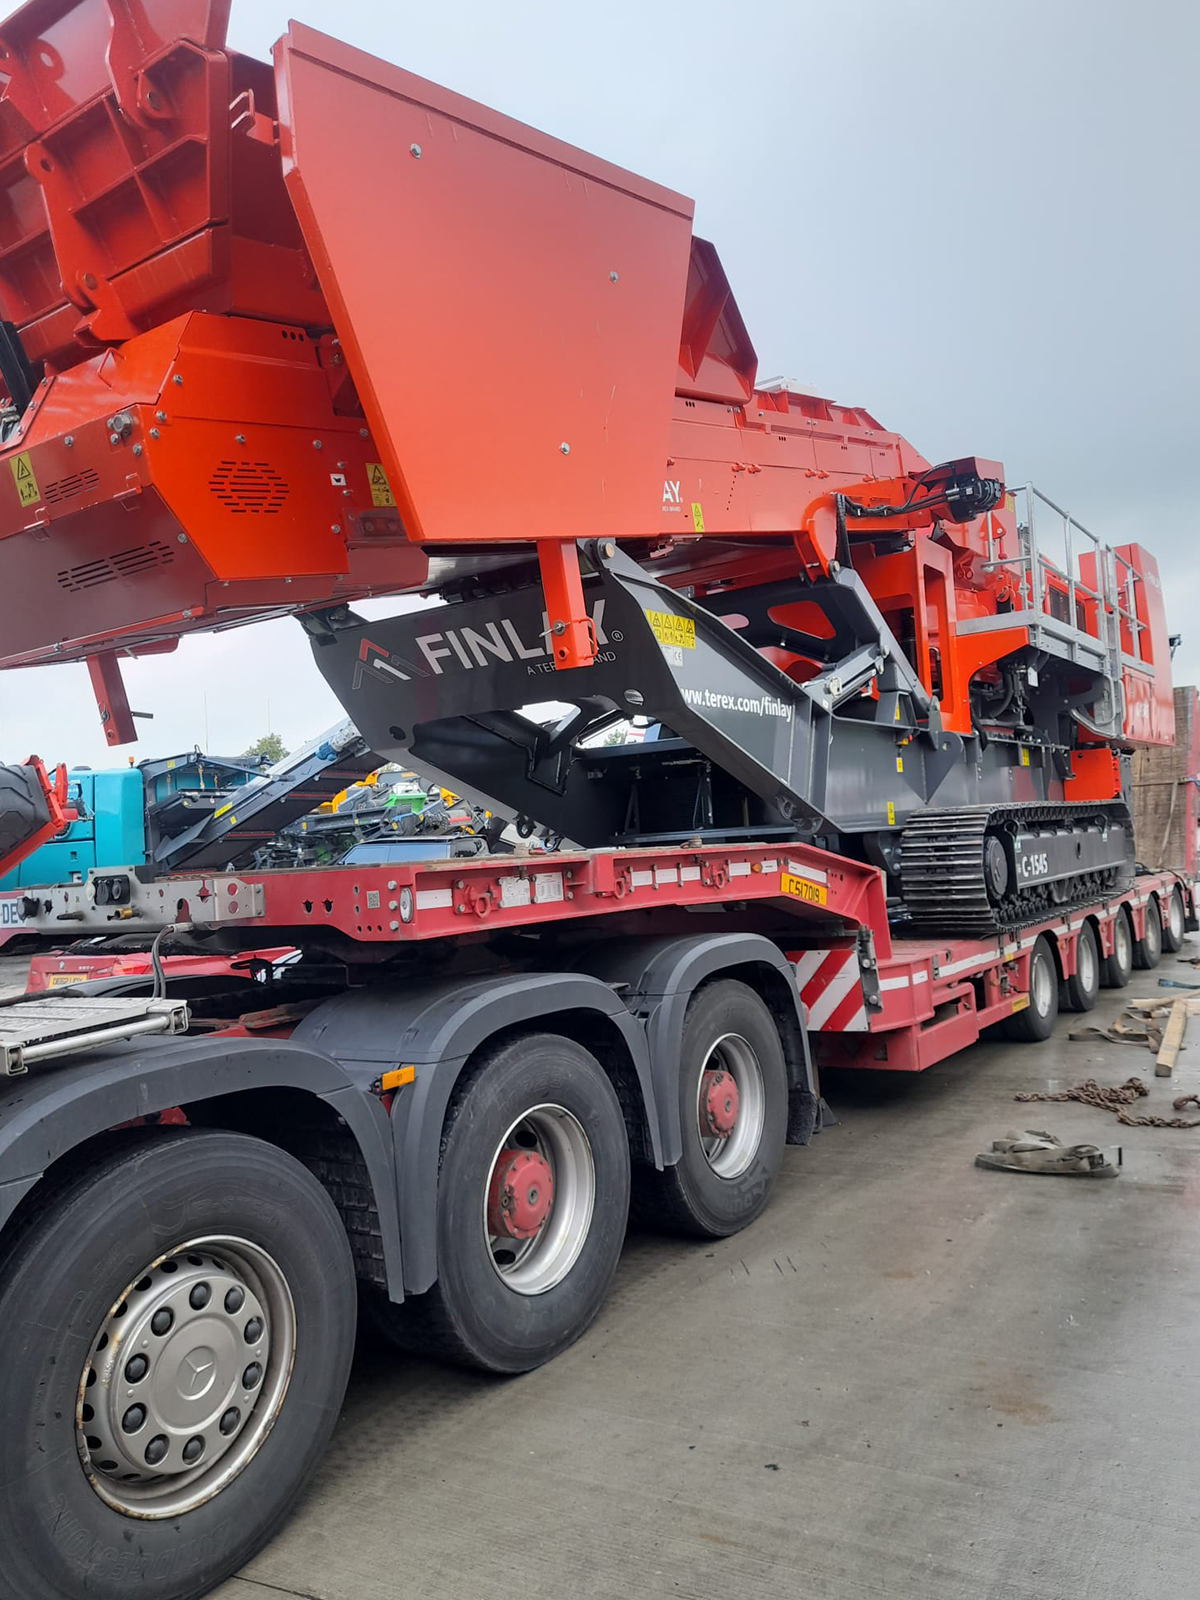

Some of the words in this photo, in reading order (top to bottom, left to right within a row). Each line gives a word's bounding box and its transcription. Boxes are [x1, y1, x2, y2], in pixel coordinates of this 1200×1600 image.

[662, 480, 680, 503] AY
[415, 599, 609, 676] FINLY
[527, 666, 536, 676] A
[540, 661, 557, 675] TER
[594, 651, 617, 664] AND
[681, 688, 792, 723] ww.terex.com/finlay
[1022, 853, 1048, 877] C-1545
